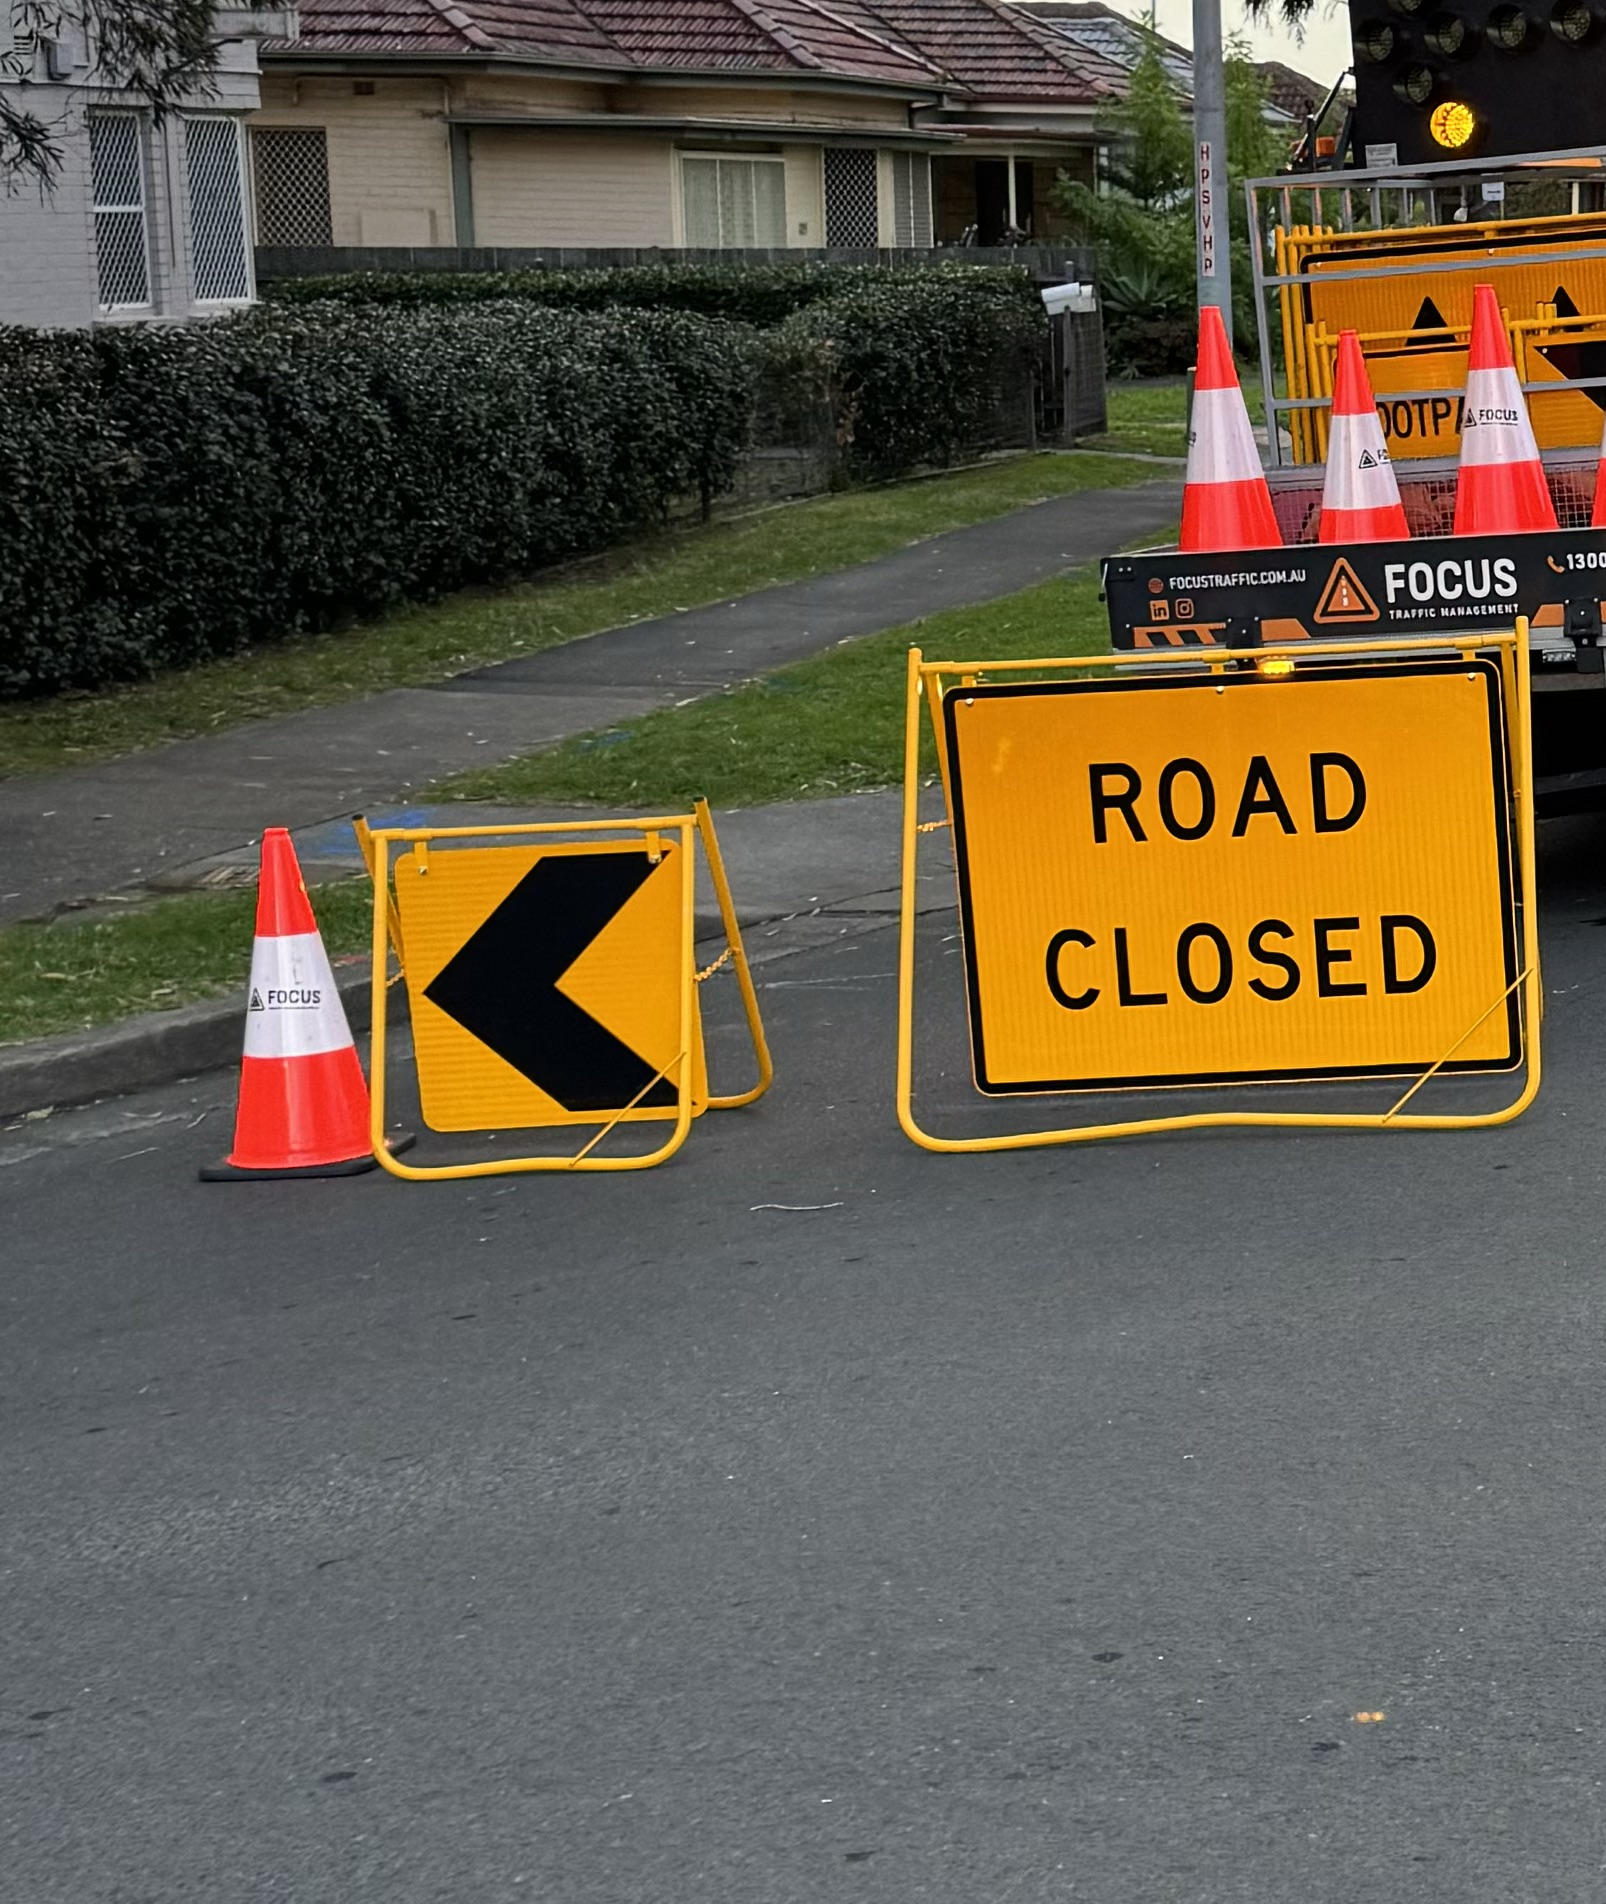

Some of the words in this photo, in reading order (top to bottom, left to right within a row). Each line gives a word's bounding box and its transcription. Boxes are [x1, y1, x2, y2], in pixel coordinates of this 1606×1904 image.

[1479, 408, 1519, 422] FOCUS
[1169, 569, 1306, 590] FOCUSTRAFFIC.COM.AU
[1384, 557, 1518, 603] FOCUS
[1389, 608, 1436, 620] TRAFFIC
[1441, 603, 1519, 617] MANAGEMENT
[1088, 751, 1368, 845] ROAD
[1045, 914, 1437, 1011] CLOSED
[267, 989, 321, 1005] FOCUS
